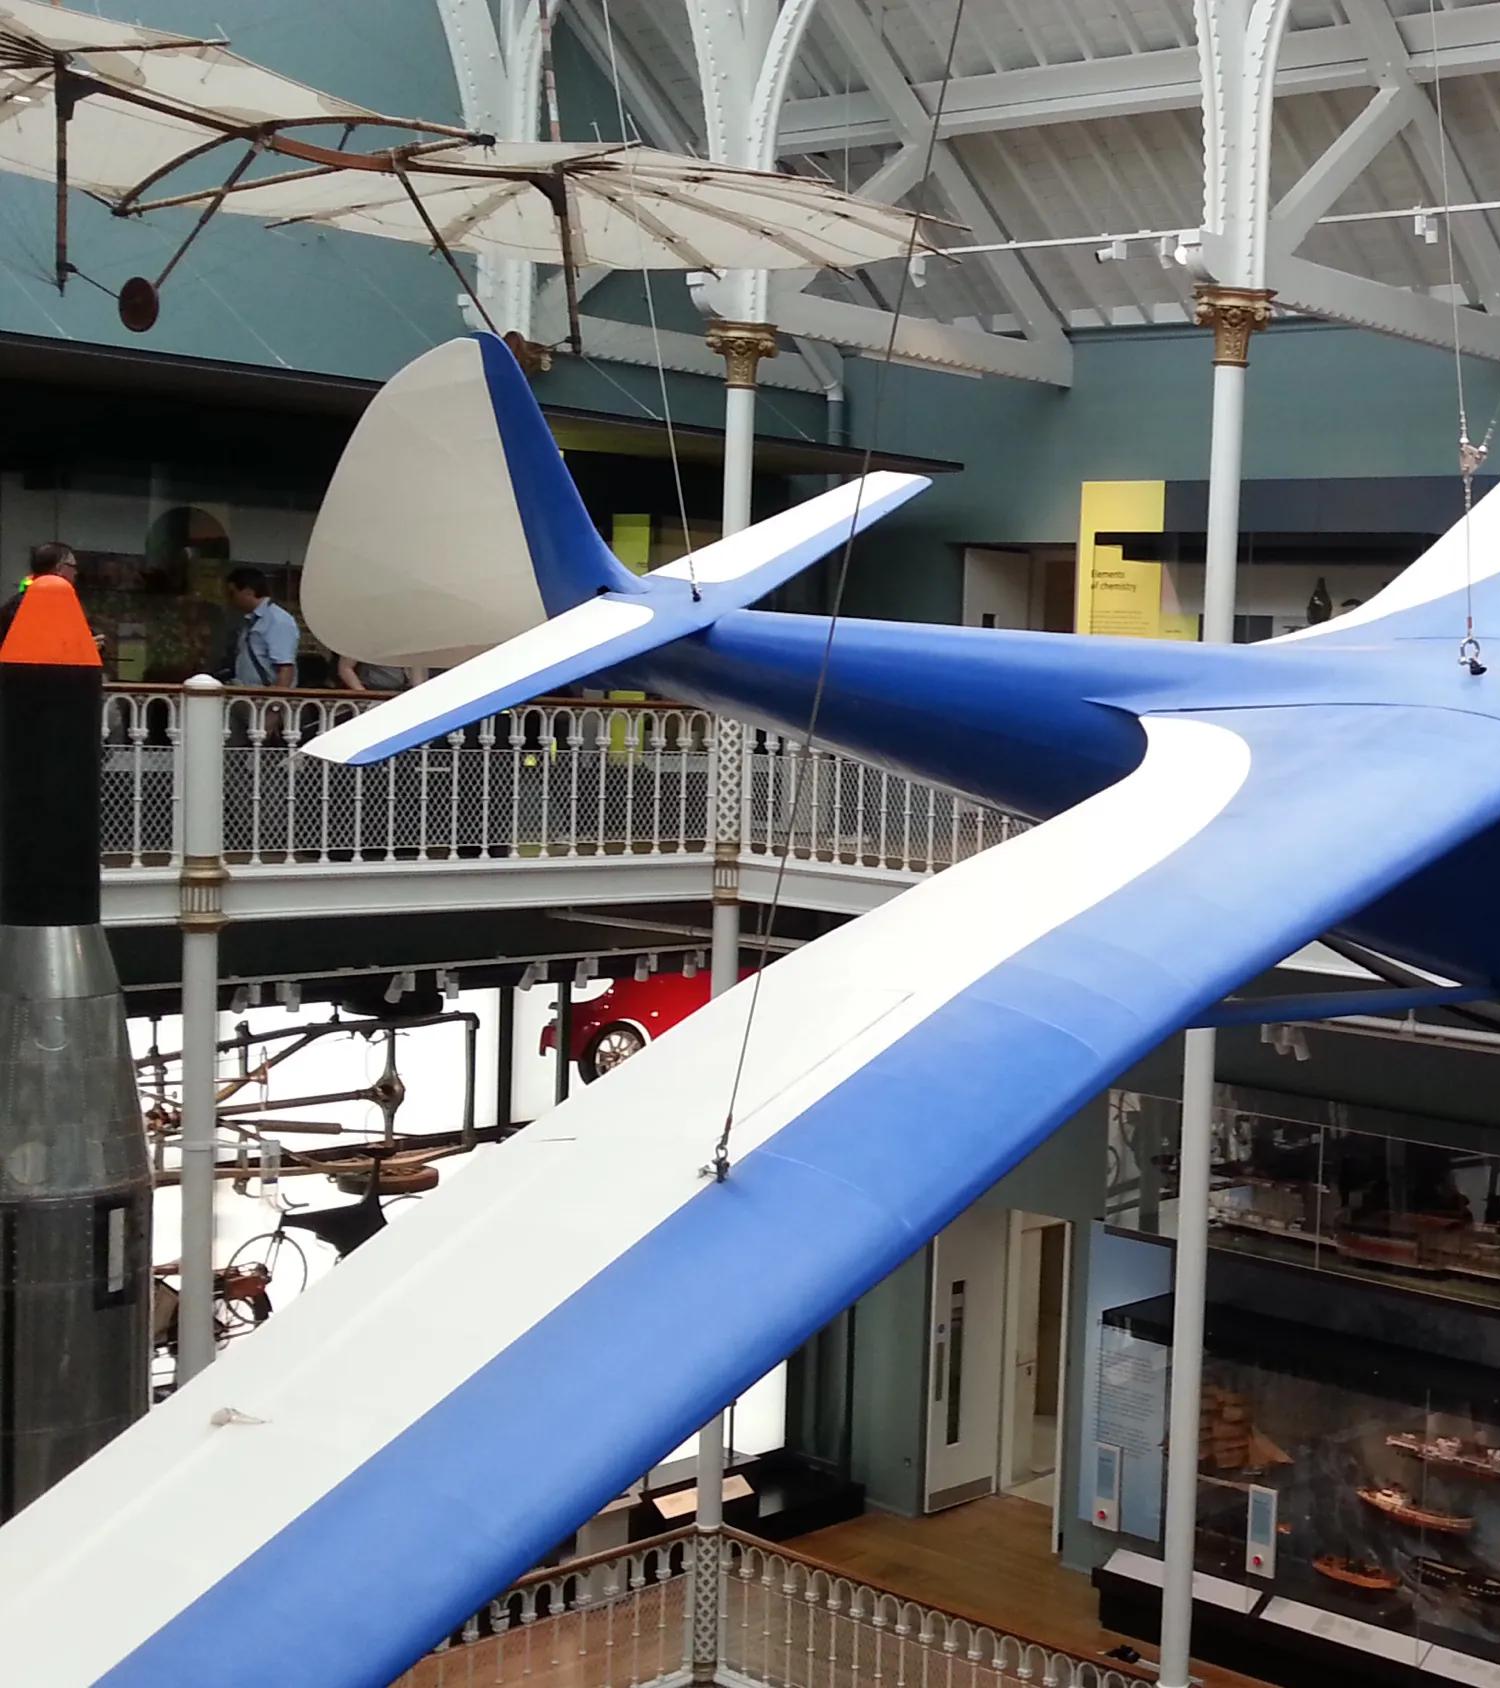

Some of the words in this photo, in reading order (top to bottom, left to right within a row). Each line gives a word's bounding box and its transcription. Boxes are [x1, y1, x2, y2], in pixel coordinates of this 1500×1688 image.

[1090, 569, 1126, 579] Elements
[1090, 580, 1099, 590] of
[1100, 582, 1137, 593] chemistry
